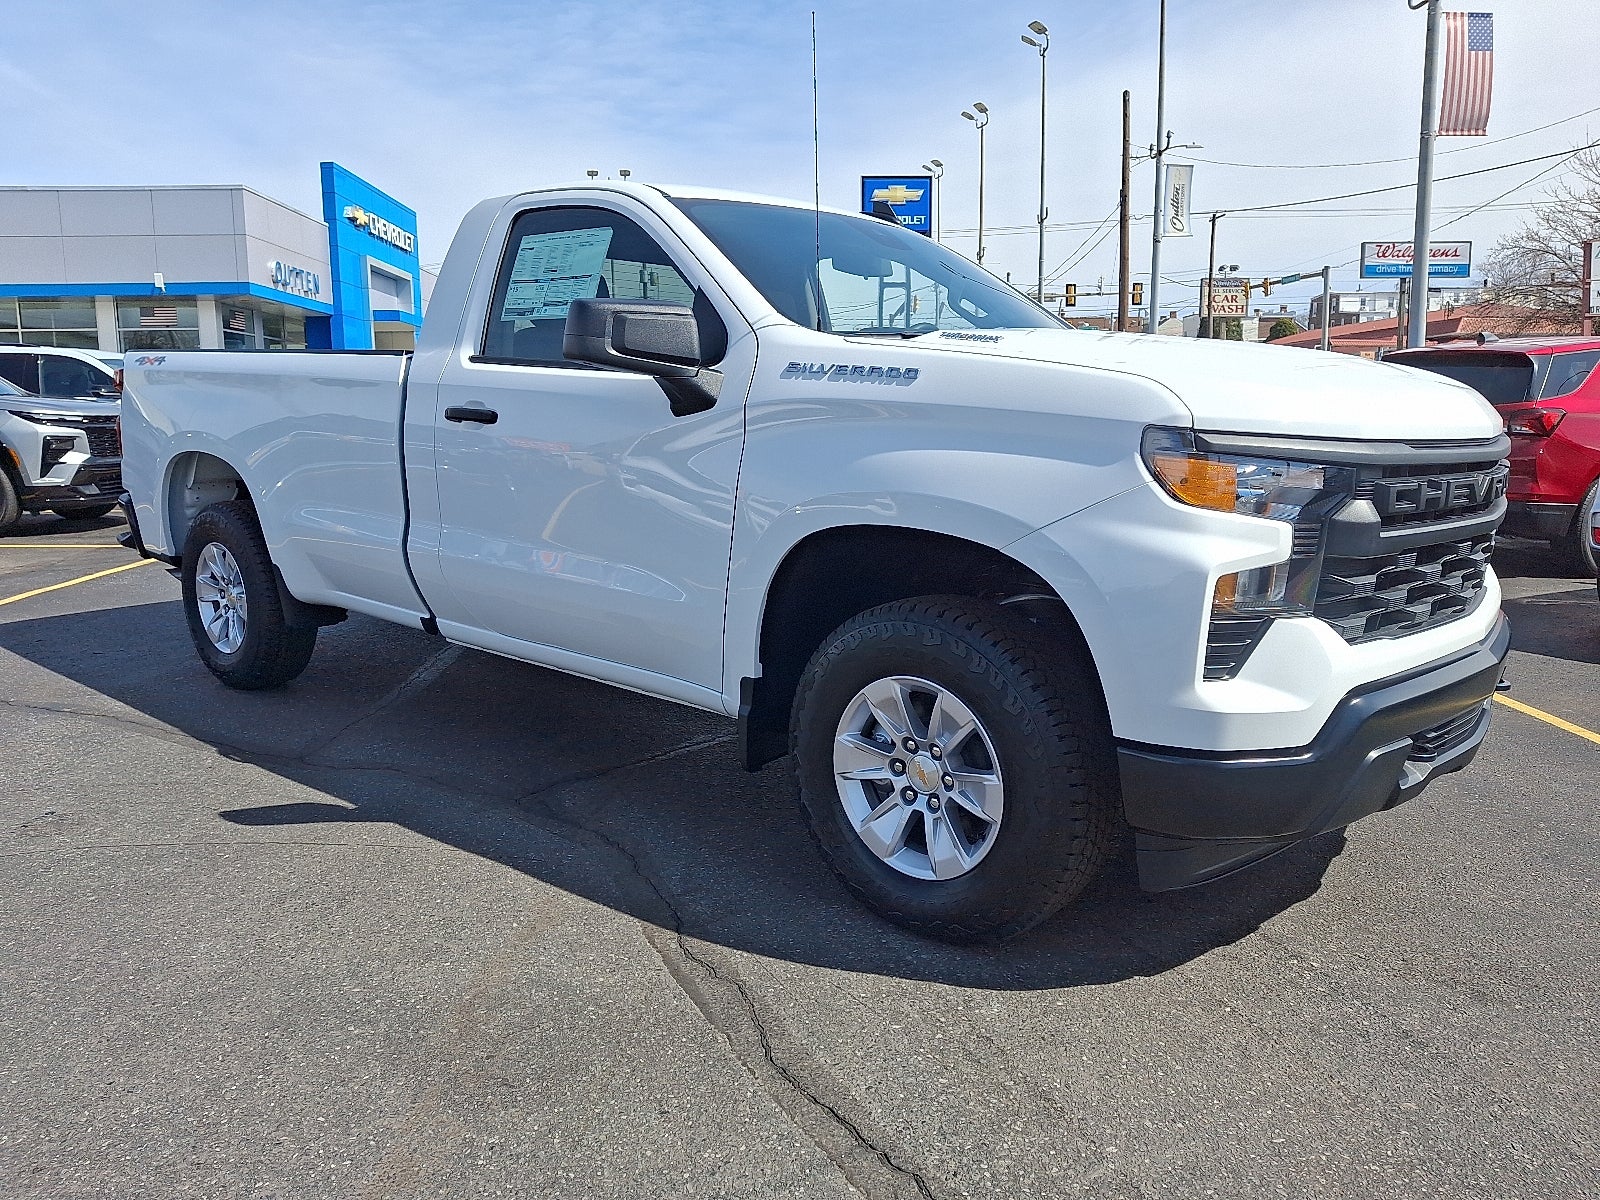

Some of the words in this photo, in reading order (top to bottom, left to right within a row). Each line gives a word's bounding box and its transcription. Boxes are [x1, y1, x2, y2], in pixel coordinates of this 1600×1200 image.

[1170, 184, 1184, 232] Outten
[369, 212, 415, 252] CHEVROLET
[1376, 243, 1460, 263] Walgeens
[272, 261, 320, 295] OUTTEN
[1376, 265, 1397, 273] drive
[1398, 265, 1413, 273] thr
[1428, 266, 1459, 275] armacy
[1212, 294, 1239, 304] CAR
[784, 361, 921, 380] SILVERADO
